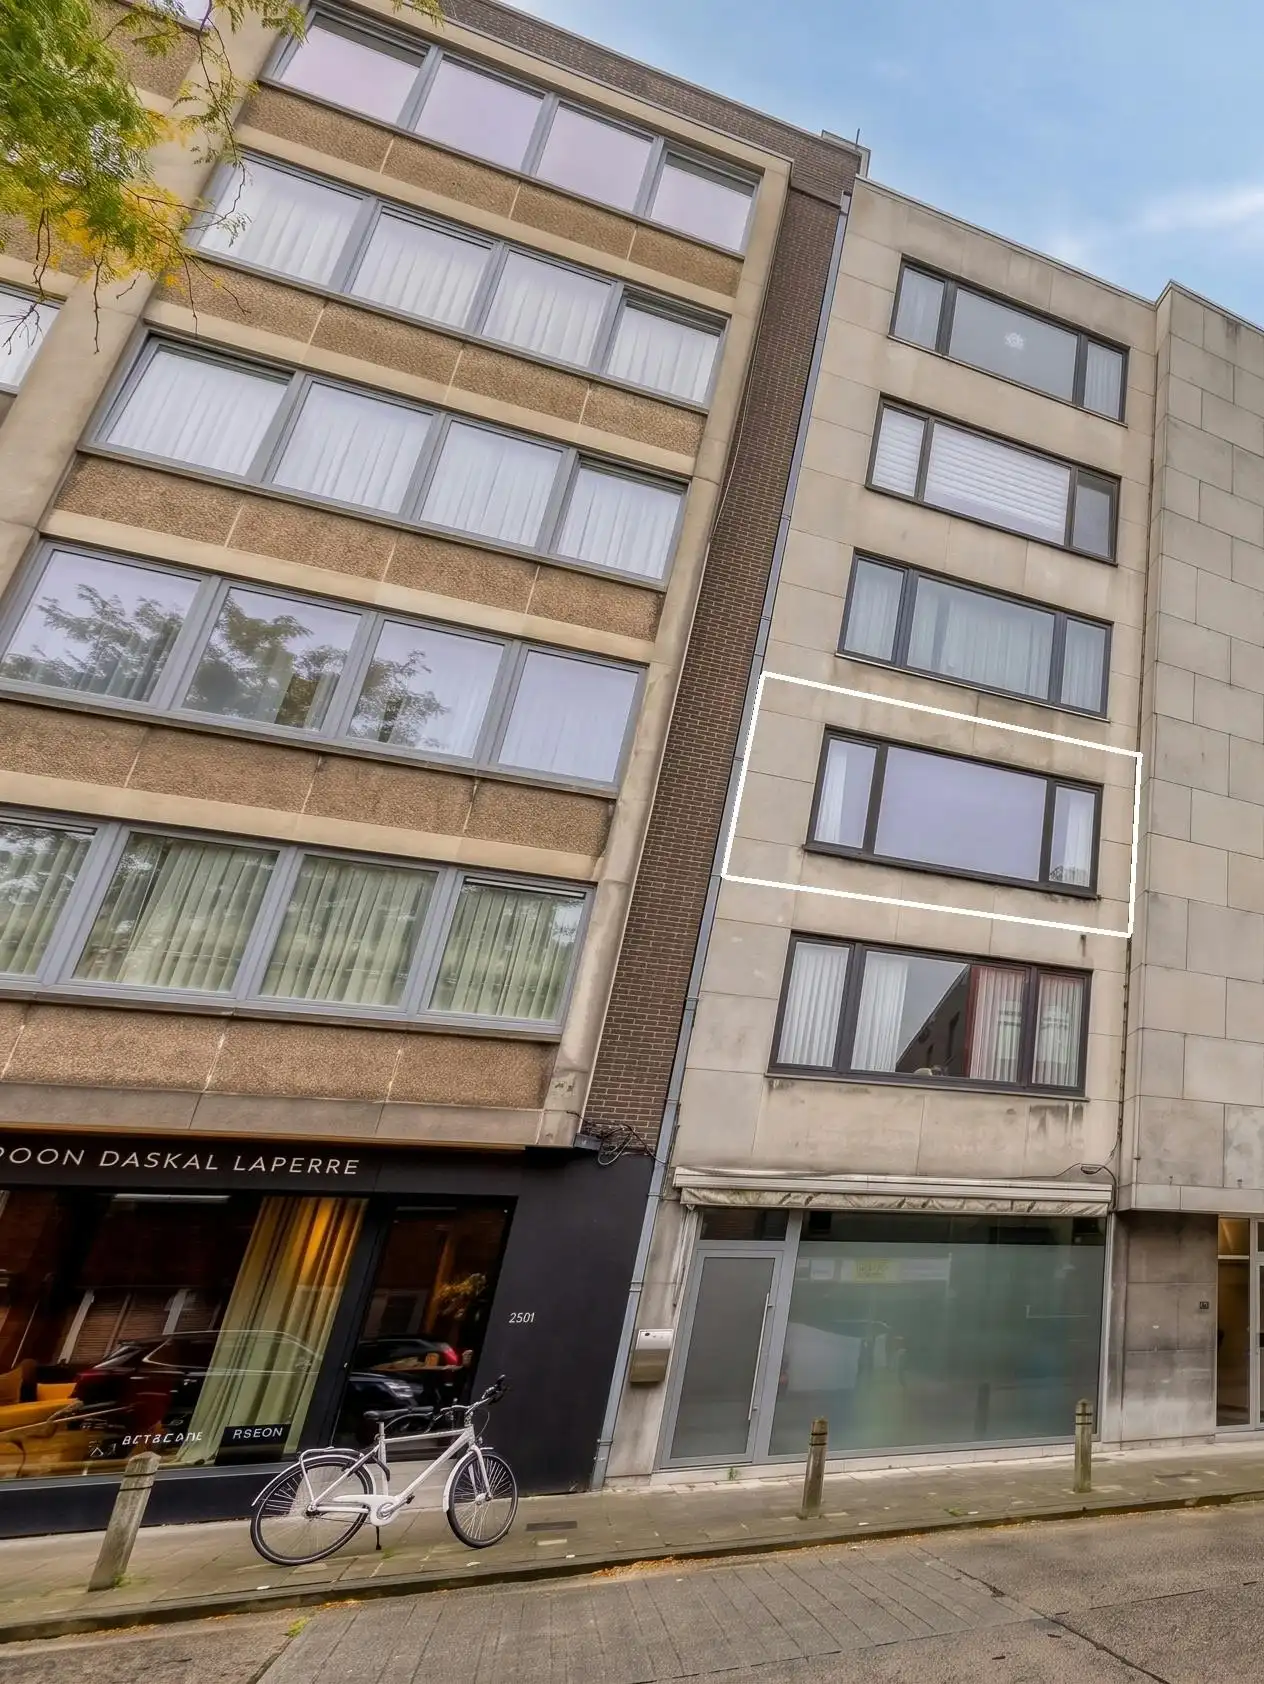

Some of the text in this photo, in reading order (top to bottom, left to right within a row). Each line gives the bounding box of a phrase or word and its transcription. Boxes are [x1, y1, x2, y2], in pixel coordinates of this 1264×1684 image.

[99, 1150, 219, 1170] DASKAL
[233, 1155, 360, 1175] LAPERRE
[508, 1312, 535, 1324] 2501
[232, 1427, 284, 1440] RSEON
